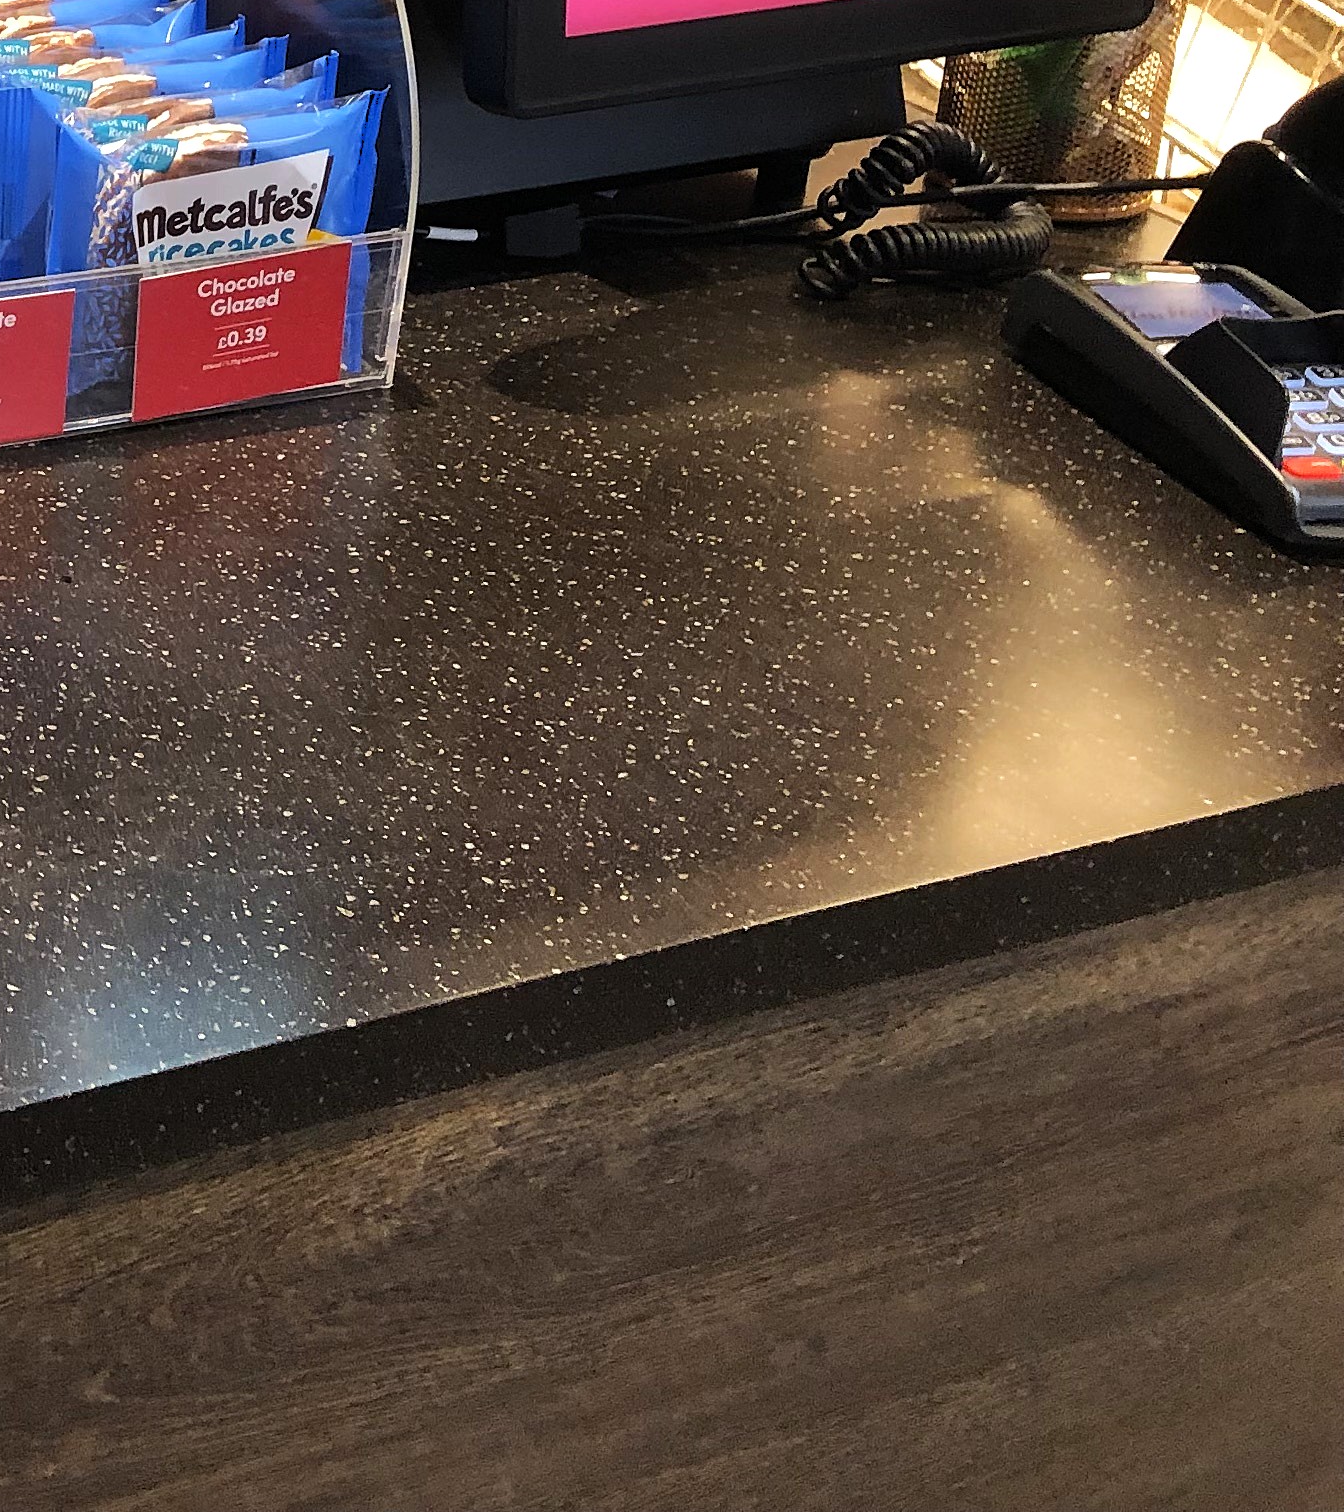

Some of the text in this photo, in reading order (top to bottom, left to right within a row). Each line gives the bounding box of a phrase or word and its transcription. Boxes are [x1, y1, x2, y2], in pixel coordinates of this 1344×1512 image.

[3, 44, 28, 57] WITH
[30, 68, 56, 80] WITH
[41, 80, 90, 102] MADE WITH
[119, 119, 146, 133] WITH
[150, 142, 176, 157] WITH
[197, 267, 296, 298] Chocolate
[210, 287, 280, 317] Glazed
[216, 325, 268, 350] £0.39
